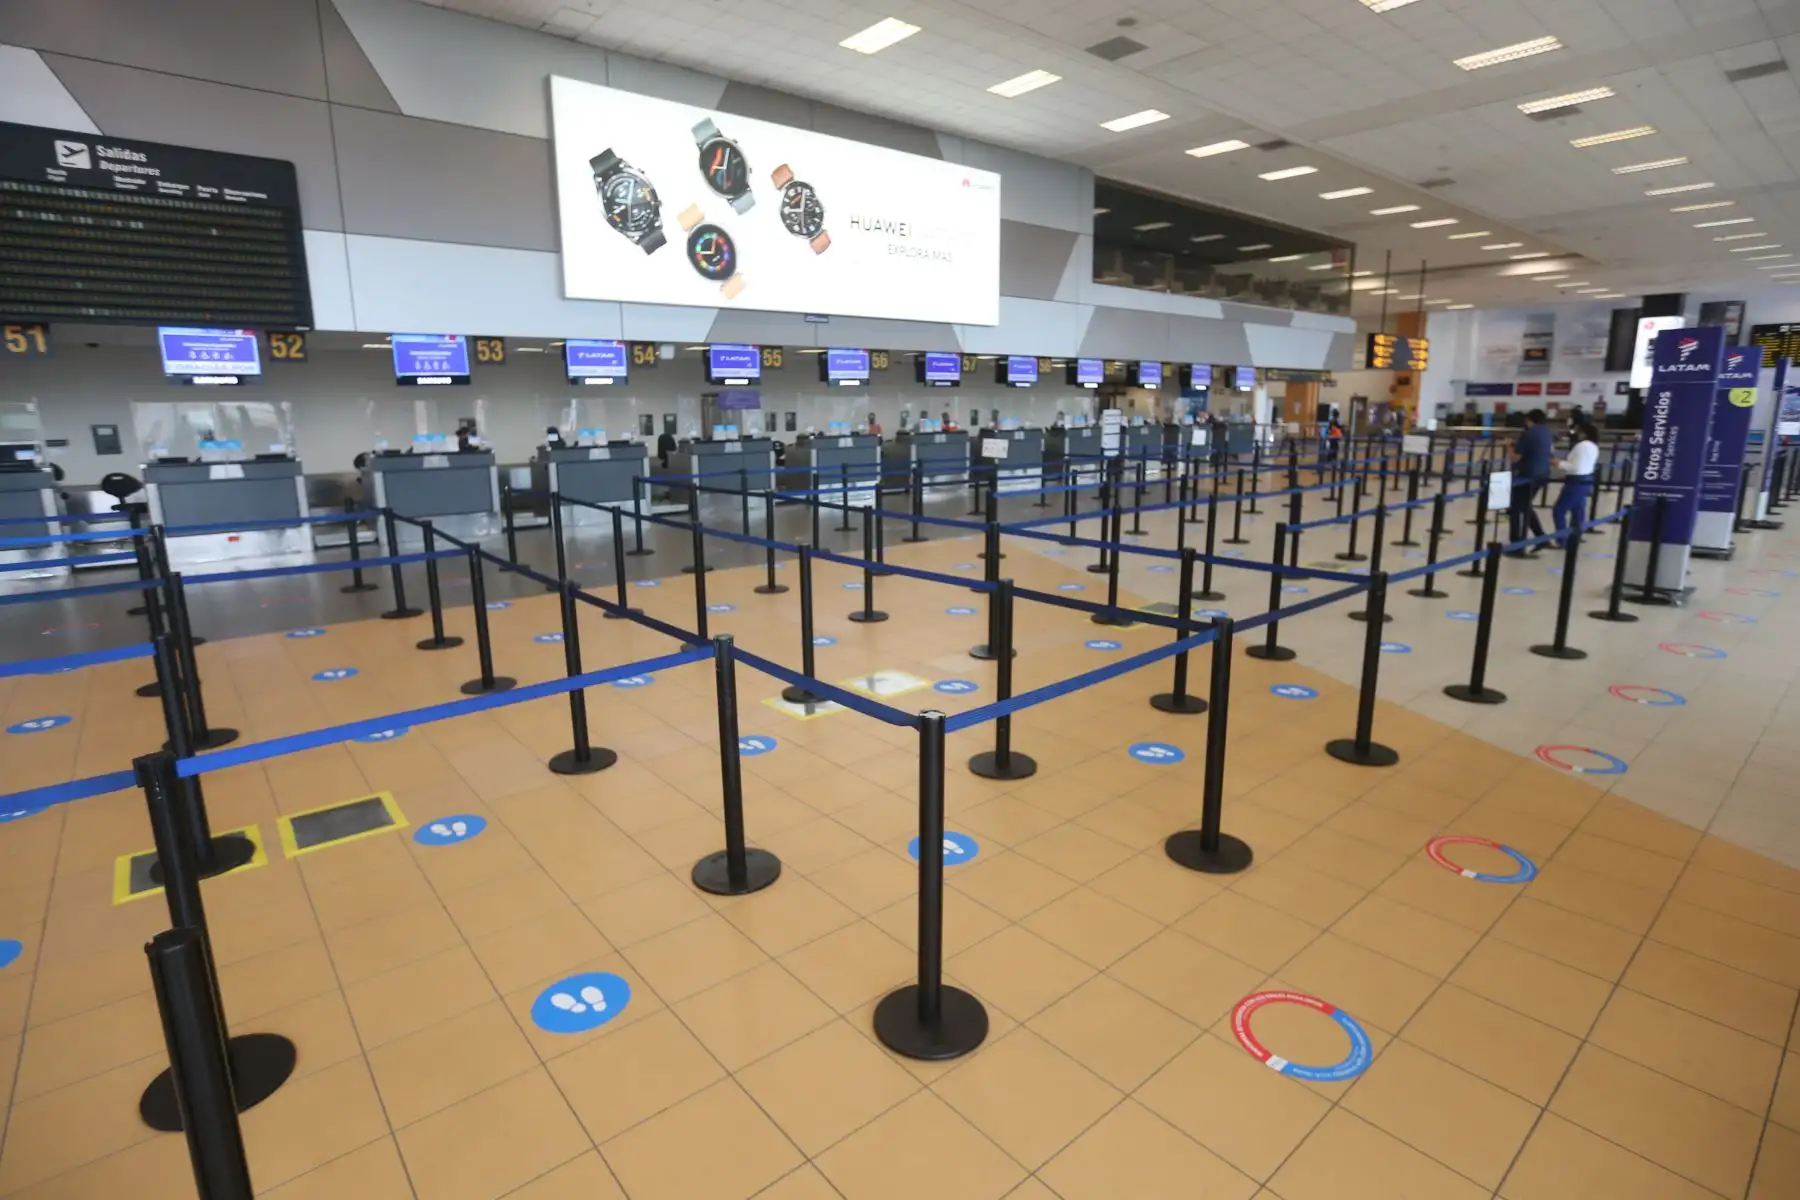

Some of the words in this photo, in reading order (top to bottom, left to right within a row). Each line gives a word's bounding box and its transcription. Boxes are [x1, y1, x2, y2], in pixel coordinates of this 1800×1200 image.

[96, 145, 147, 163] Salidas
[99, 160, 160, 176] Departures
[850, 214, 912, 237] HUAWEI
[887, 243, 929, 261] EXPLORA
[4, 325, 47, 353] 51
[270, 334, 304, 358] 52
[477, 340, 504, 361] 53
[633, 344, 655, 364] 54
[763, 349, 782, 367] 55
[872, 352, 888, 368] 56
[962, 356, 977, 372] 57
[1658, 364, 1711, 373] LATAM
[1740, 390, 1752, 404] 2
[1649, 390, 1672, 445] Servicios
[1664, 425, 1679, 457] Services
[1643, 447, 1662, 481] Otros
